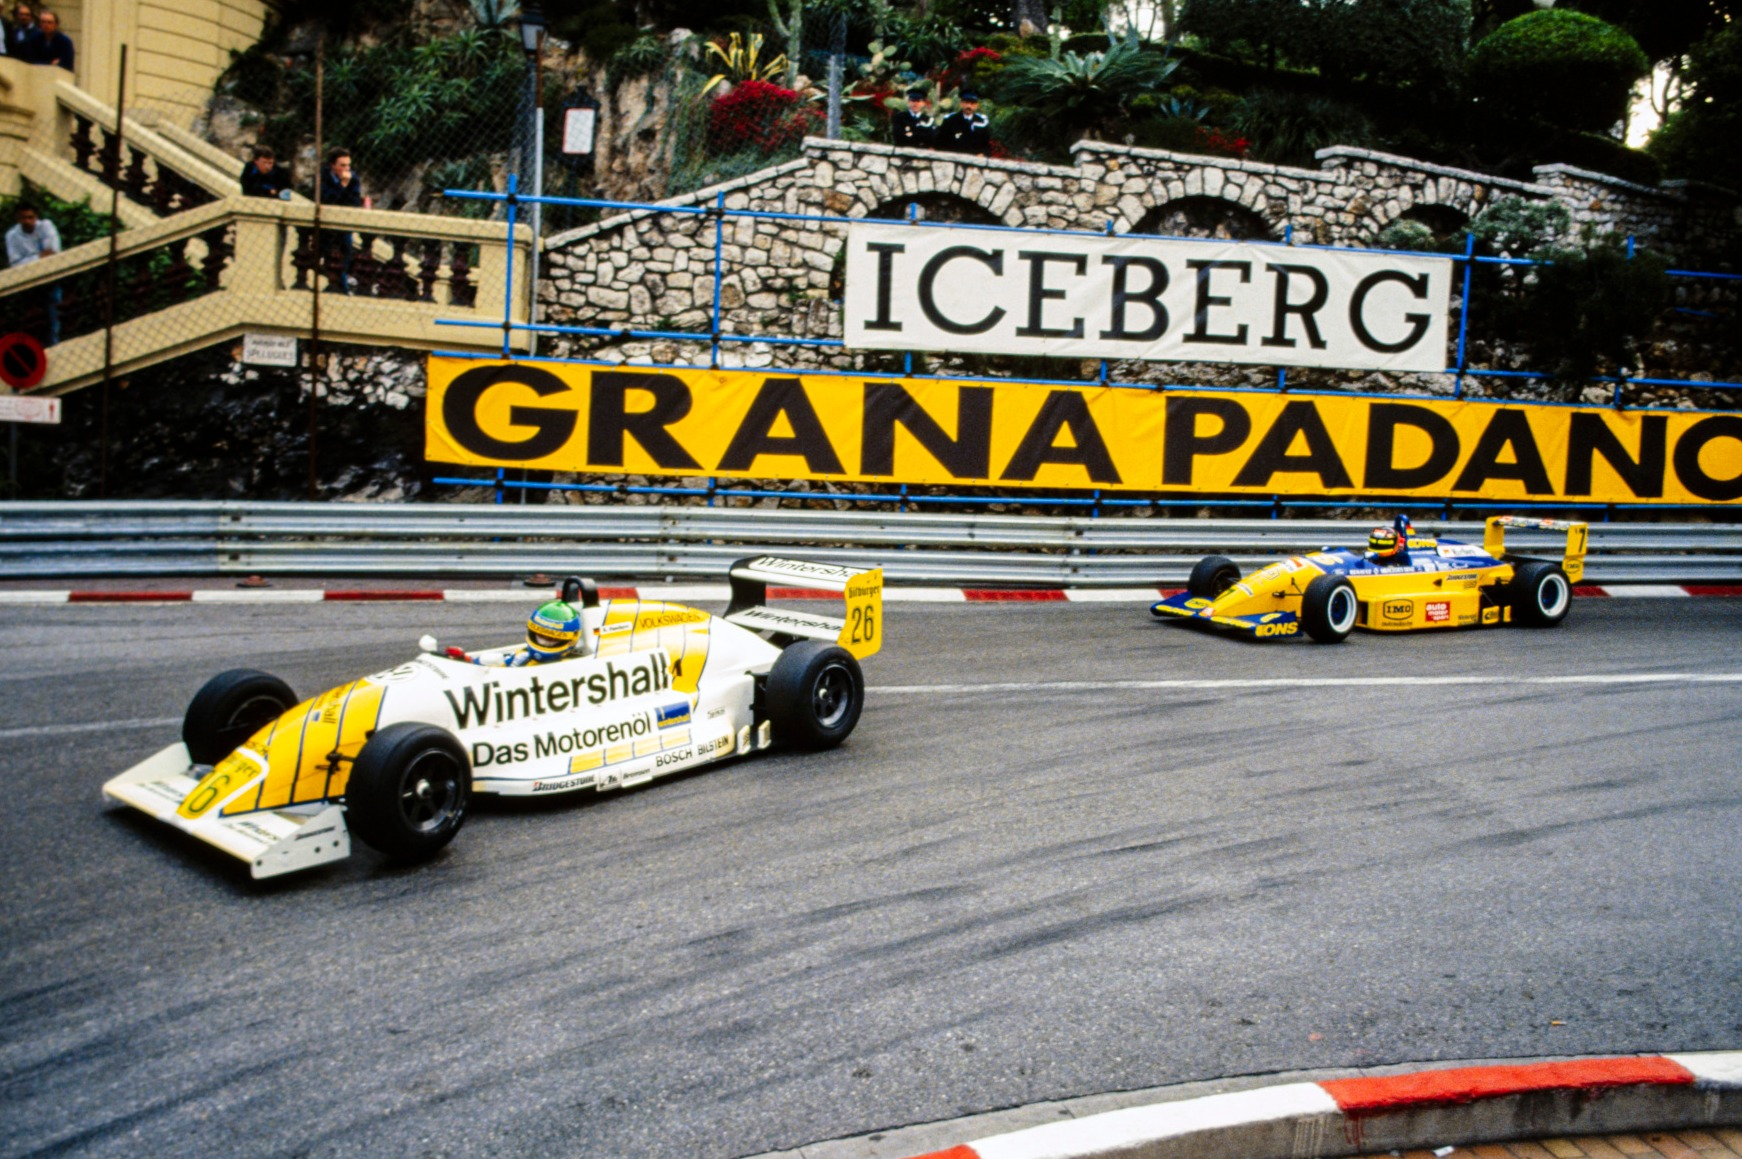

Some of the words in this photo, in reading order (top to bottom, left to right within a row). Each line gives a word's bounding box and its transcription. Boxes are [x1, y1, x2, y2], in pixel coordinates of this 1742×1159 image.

[863, 241, 1432, 354] ICEBERG
[442, 363, 1124, 484] GRANA
[1161, 395, 1742, 501] PADANO
[639, 613, 701, 630] VOLKSWAGEN
[850, 603, 875, 645] 26
[1386, 605, 1411, 614] IMO
[1426, 603, 1447, 611] auto
[443, 651, 670, 730] Wintershall
[472, 741, 530, 768] Das
[533, 711, 653, 759] Motorenöl
[655, 748, 694, 768] BOSCH
[697, 735, 730, 756] BILSTEIN
